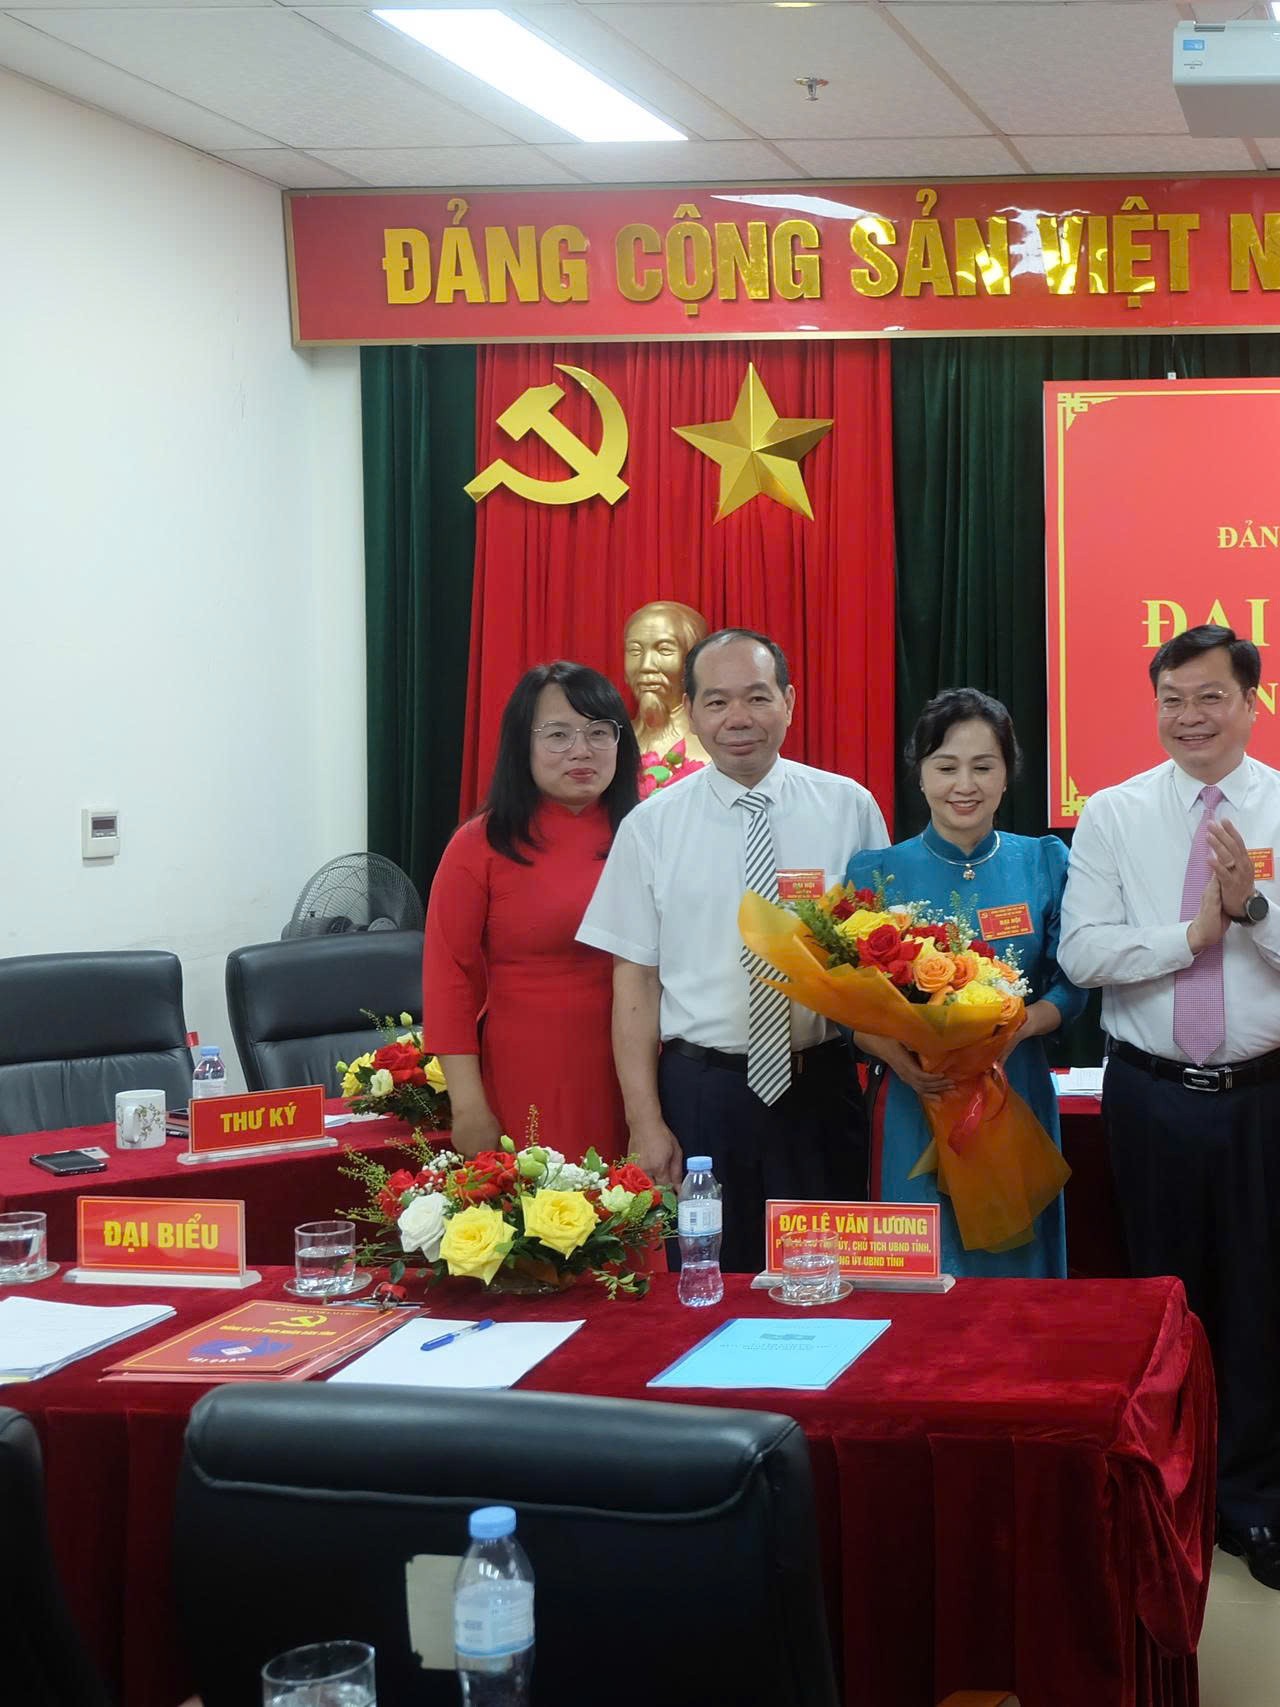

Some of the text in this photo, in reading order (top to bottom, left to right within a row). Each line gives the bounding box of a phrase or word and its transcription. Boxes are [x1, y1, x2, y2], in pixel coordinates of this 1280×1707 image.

[382, 198, 589, 305] ĐẢNG
[614, 204, 822, 316] CỘNG
[849, 189, 1010, 298] SẢN
[1036, 196, 1201, 309] VIỆT
[220, 1101, 297, 1133] THƯ KÝ
[104, 1213, 219, 1253] ĐẠI BIỂU
[779, 1212, 928, 1236] Đ/C LÊ VĂN LƯƠNG
[888, 1242, 909, 1252] UBND
